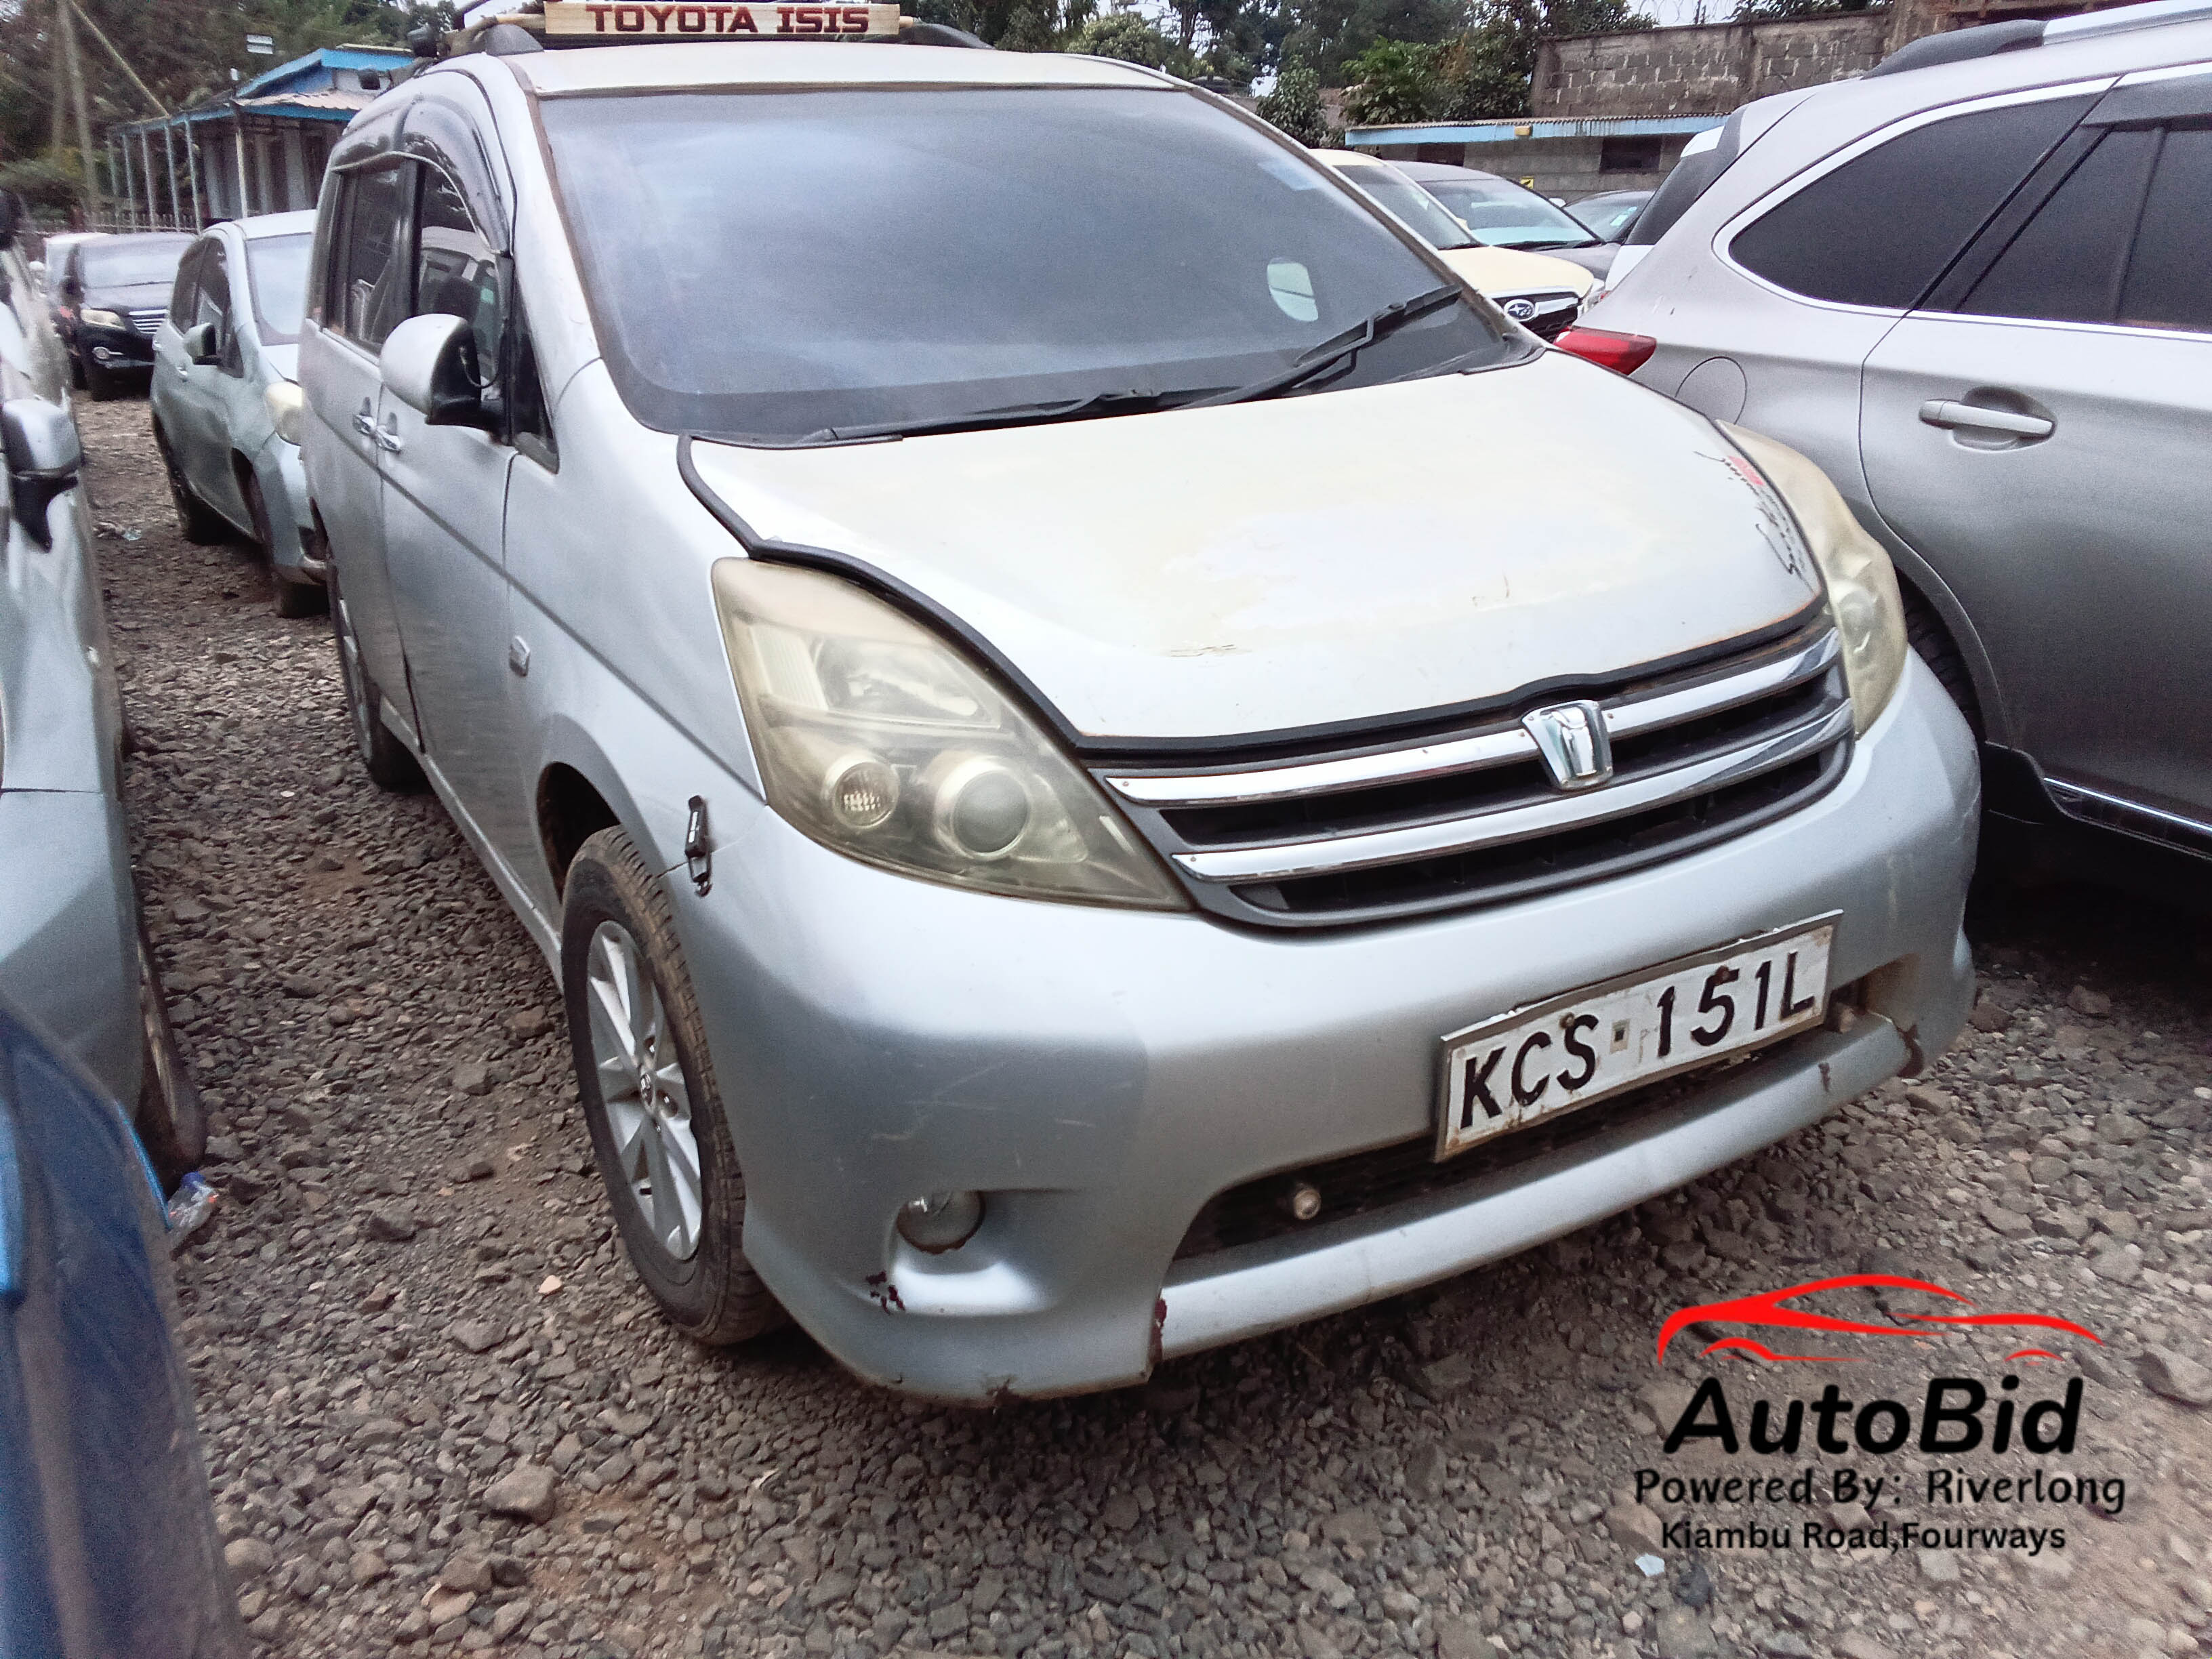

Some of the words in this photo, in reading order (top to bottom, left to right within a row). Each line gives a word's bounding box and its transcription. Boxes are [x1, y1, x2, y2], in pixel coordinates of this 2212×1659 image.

[586, 5, 758, 33] TOYOTA
[777, 7, 869, 33] ISIS
[1459, 1013, 1600, 1130] KCS
[1656, 951, 1815, 1058] 151L
